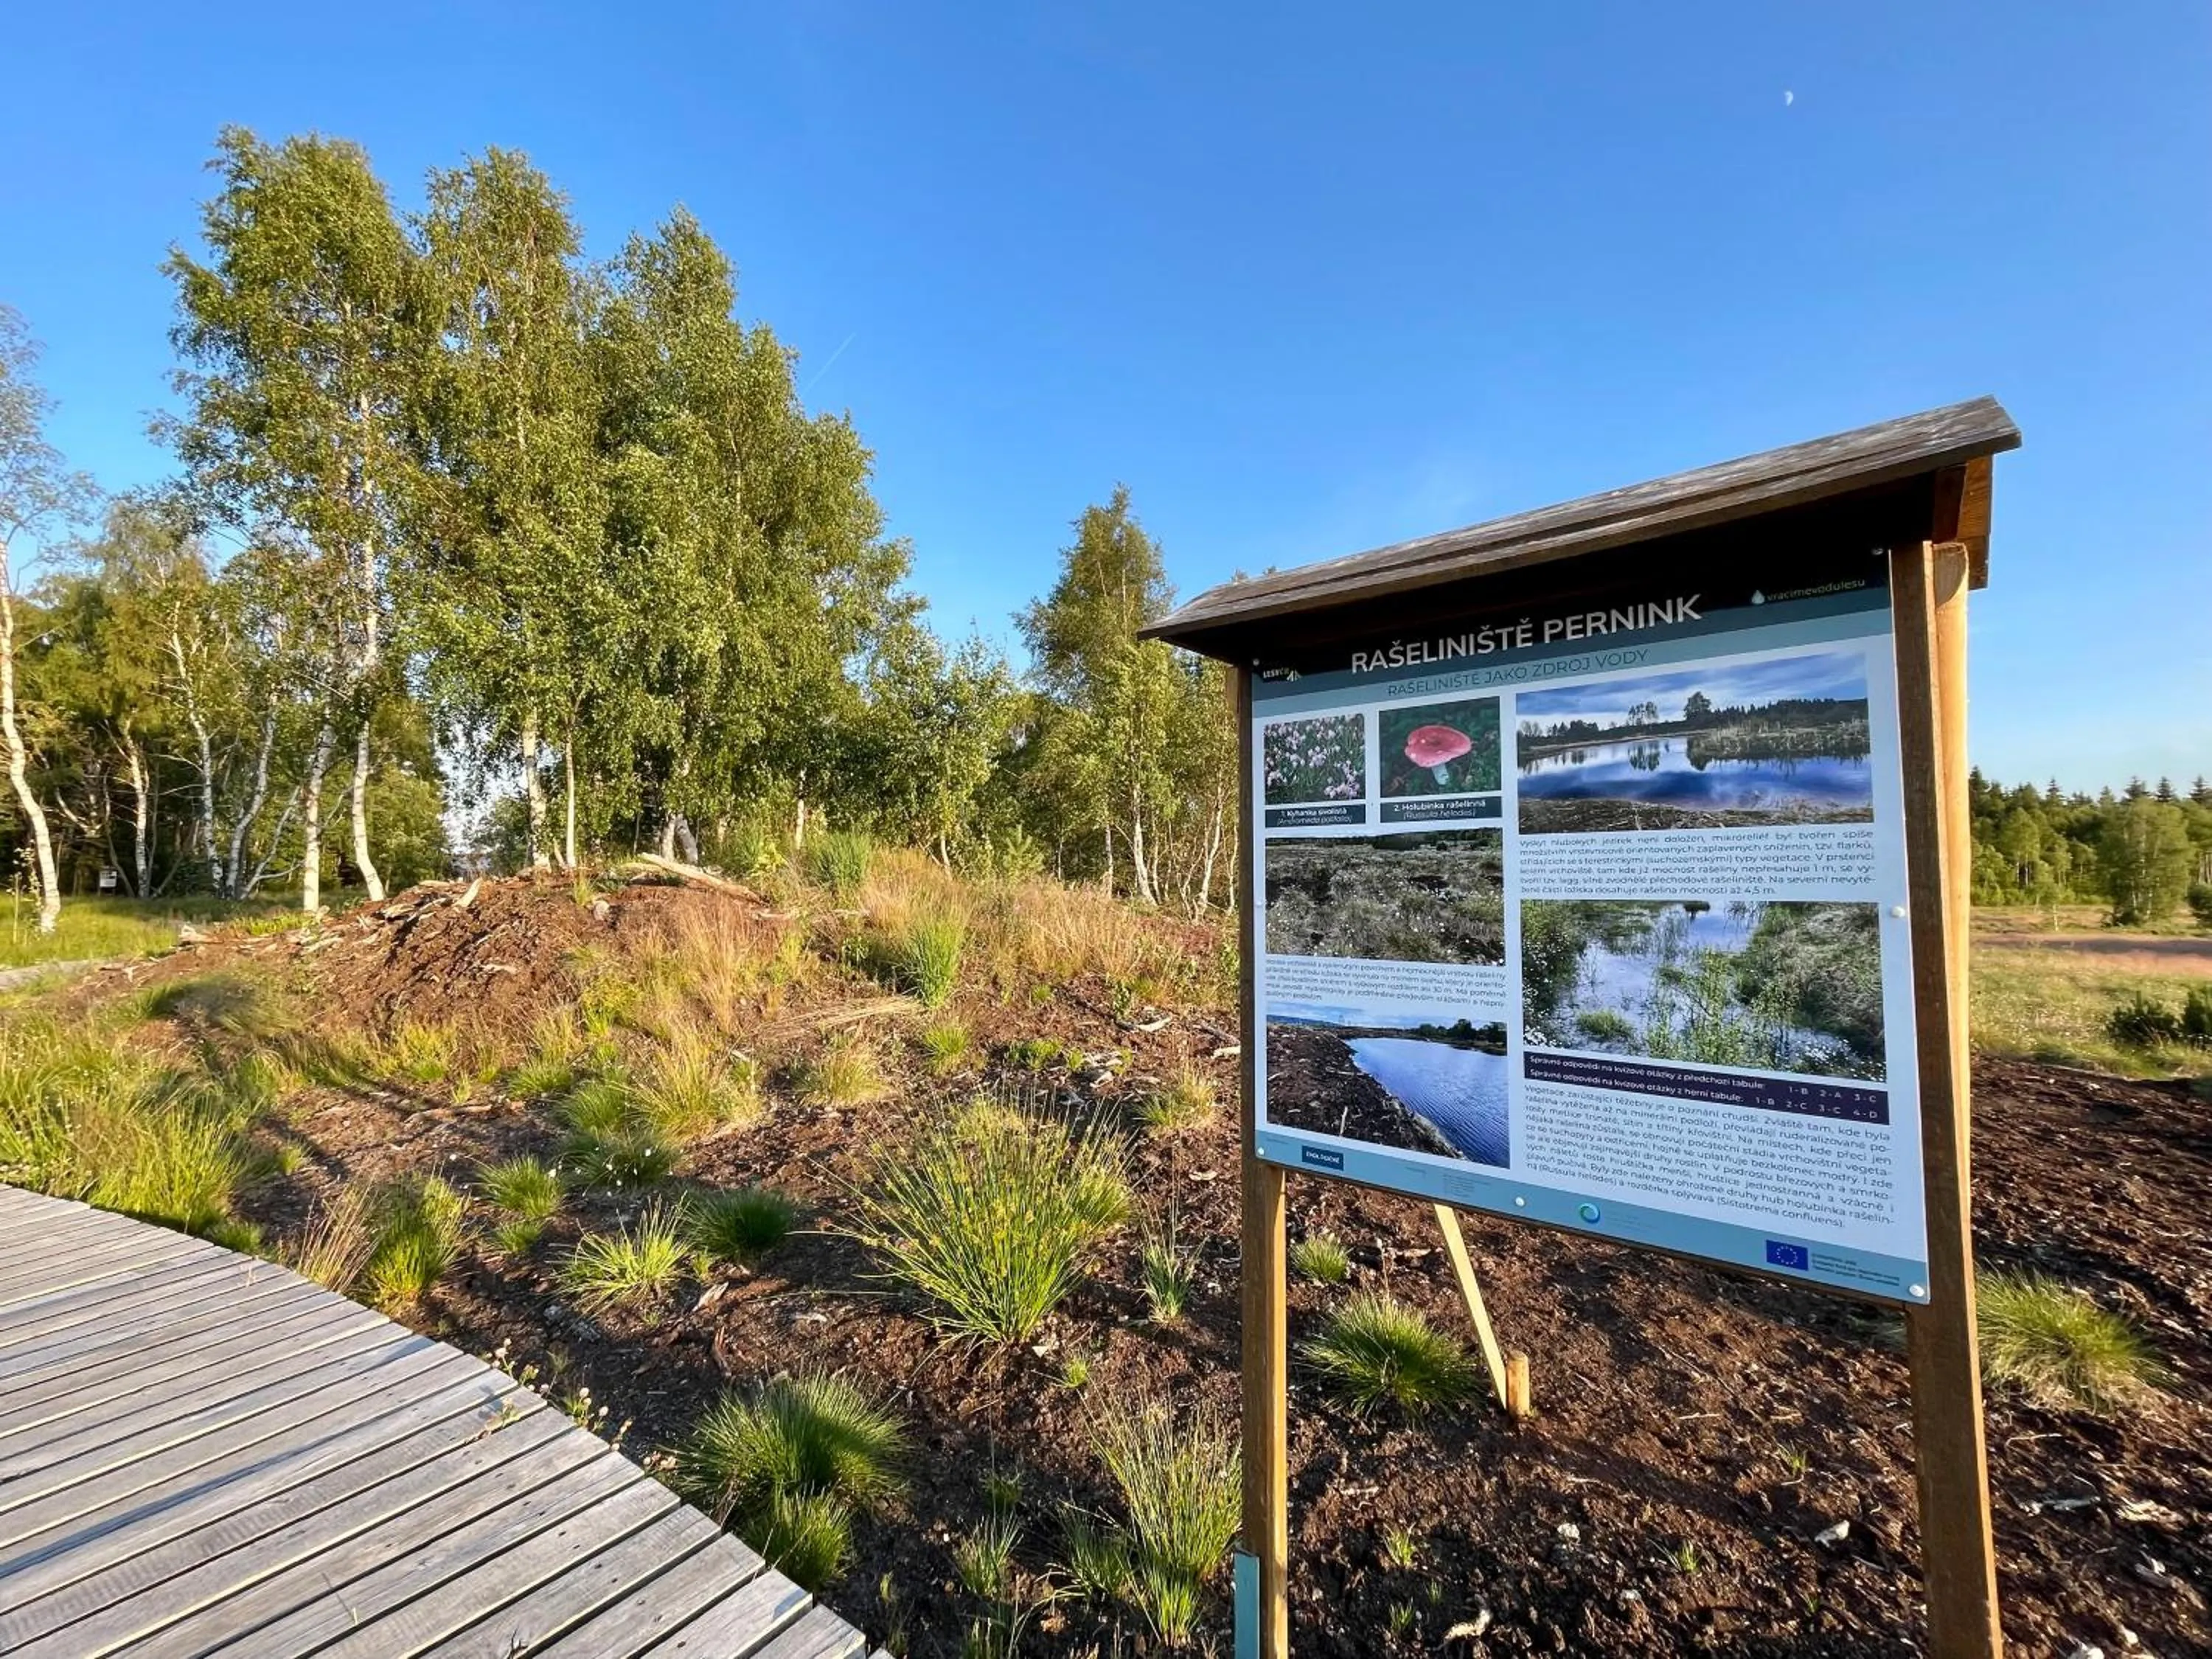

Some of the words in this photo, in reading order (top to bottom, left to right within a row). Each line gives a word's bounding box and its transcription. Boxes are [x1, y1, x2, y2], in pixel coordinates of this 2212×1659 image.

[1352, 617, 1534, 674] RAŠELINIŠTĚ
[1543, 594, 1703, 644] PERNINK
[1484, 666, 1527, 684] JAKO
[1533, 658, 1591, 677] ZDROJ
[1595, 648, 1649, 668] VODY
[1799, 831, 1834, 839] tvořen
[1735, 855, 1758, 864] typy
[1769, 875, 1783, 883] Na
[1744, 886, 1759, 894] 4,5
[1838, 1127, 1860, 1137] kde
[1865, 1130, 1889, 1141] byla
[1738, 1135, 1752, 1144] Na
[1810, 1147, 1832, 1156] kde
[1871, 1155, 1891, 1164] jen
[1870, 1179, 1893, 1189] zde
[1761, 1194, 1784, 1205] hub
